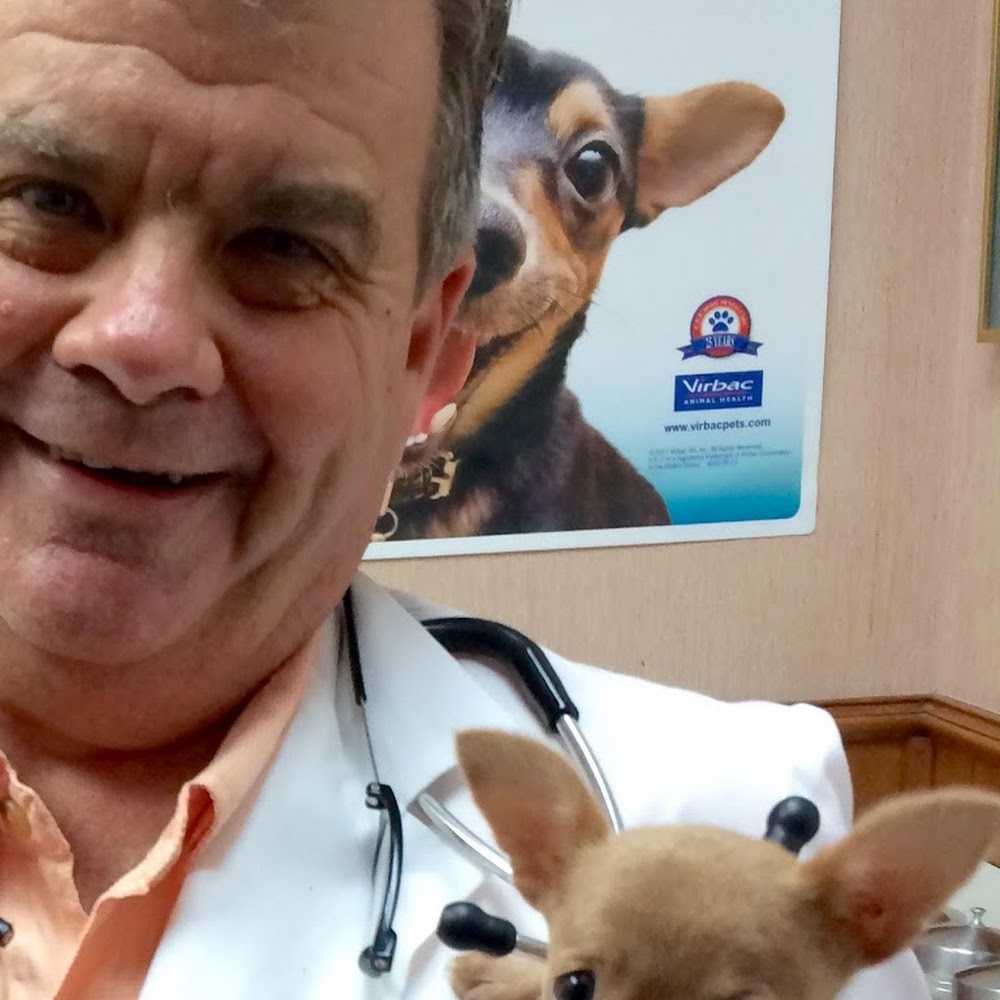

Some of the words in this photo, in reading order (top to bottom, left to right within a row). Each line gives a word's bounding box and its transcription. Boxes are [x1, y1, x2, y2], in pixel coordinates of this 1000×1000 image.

[682, 378, 755, 394] Virbac
[683, 397, 716, 405] ANIMAL
[719, 395, 754, 403] HEALTH
[663, 418, 772, 433] www.virbacpets.com
